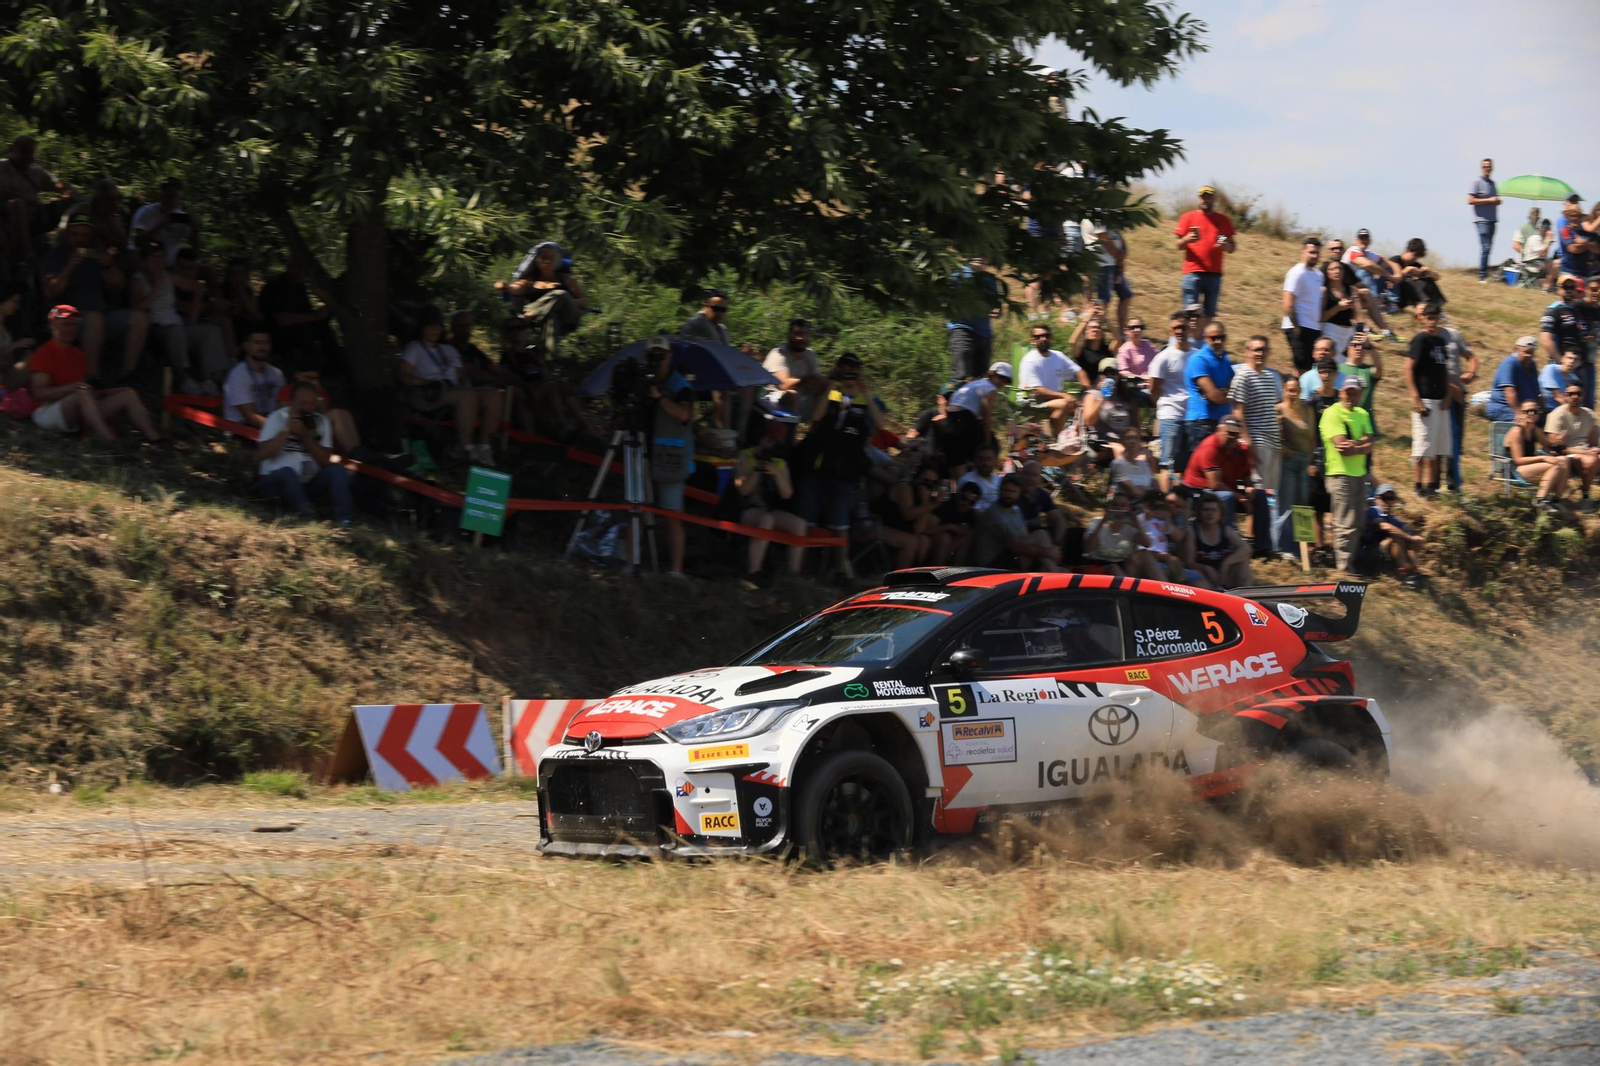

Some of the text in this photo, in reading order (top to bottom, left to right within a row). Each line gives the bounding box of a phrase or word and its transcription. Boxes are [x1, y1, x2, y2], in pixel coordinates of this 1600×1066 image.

[1201, 611, 1225, 645] 5
[1134, 628, 1181, 643] S.Pérez
[1136, 639, 1207, 657] A.Coronado
[1128, 671, 1148, 680] RACC
[1167, 652, 1284, 695] WERACE
[873, 680, 906, 690] RENTAL
[876, 687, 925, 697] MOTORBIKE
[947, 688, 967, 715] 5
[977, 691, 1001, 704] La
[962, 726, 995, 737] Recalvi
[694, 745, 743, 760] PIRELLI
[966, 745, 1014, 756] recoletas salud
[705, 815, 735, 828] RACC
